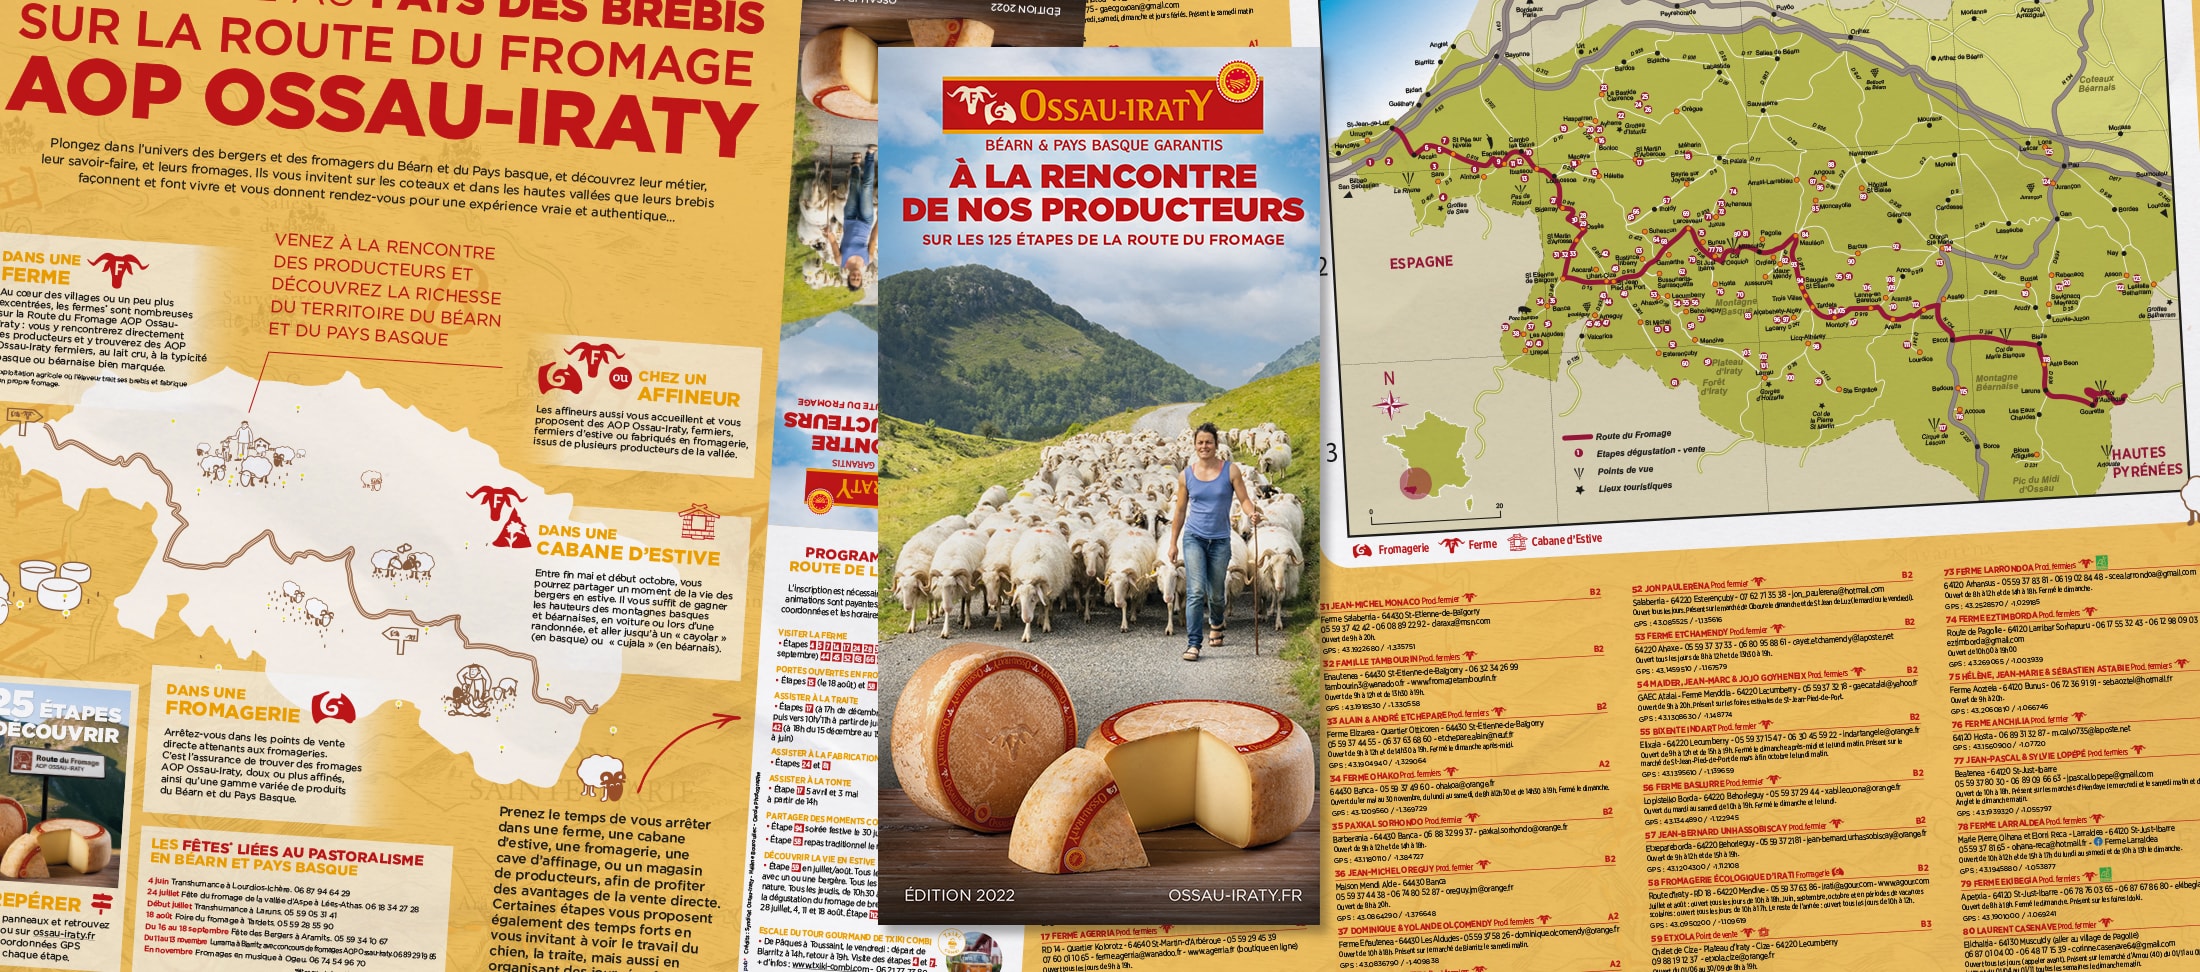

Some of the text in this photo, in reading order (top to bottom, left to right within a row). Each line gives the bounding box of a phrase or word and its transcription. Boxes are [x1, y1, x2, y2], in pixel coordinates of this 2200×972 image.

[498, 0, 587, 22] DES
[601, 0, 764, 34] BREBIS
[990, 2, 1060, 16] ÉDITION 2022
[18, 2, 753, 86] SUR LA ROUTE DU FROMAGE
[2079, 75, 2114, 84] Coteaux
[2078, 83, 2115, 93] Béarnais
[5, 55, 759, 158] AOP OSSAU-IRATY
[1020, 88, 1213, 123] OSSAU-IRATY
[985, 136, 1222, 152] BÉARN & PAYS BASQUE GARANTIS
[50, 137, 706, 192] Plongez dans l'univers des bergers et des fromagers du Béarn et du Pays basque, et découvrez leur métier,
[949, 157, 1256, 188] À LA RENCONTRE
[902, 197, 1304, 222] DE NOS PRODUCTEURS
[275, 232, 495, 260] VENEZ À LA RENCONTRE
[922, 231, 1284, 245] SUR LES 125 ÉTAPES DE LA ROUTE DU FROMAGE
[2, 250, 81, 266] DANS UNE
[1390, 254, 1453, 269] ESPAGNE
[1, 266, 70, 285] FERME
[274, 255, 473, 280] DES PRODUCTEURS ET
[272, 276, 501, 305] DÉCOUVREZ LA RICHESSE
[270, 299, 501, 327] DU TERRITOIRE DU BÉARN
[269, 321, 448, 346] ET DU PAYS BASQUE
[612, 373, 628, 383] ou
[638, 370, 706, 385] CHEZ UN
[1384, 371, 1394, 385] N
[1976, 373, 2018, 383] Montagne
[1976, 382, 2019, 391] Béarnaise
[637, 386, 740, 407] AFFINEUR
[1596, 430, 1671, 441] Route du Fromage
[1326, 442, 1337, 462] 3
[1596, 449, 1624, 459] Etapes
[1626, 447, 1675, 457] dégustation
[1683, 445, 1705, 453] vente
[2112, 446, 2166, 460] HAUTES
[832, 459, 875, 469] GARANTIS
[1597, 466, 1623, 475] Points
[1626, 465, 1636, 473] de
[2113, 461, 2183, 478] PYRÉNÉES
[1623, 481, 1672, 491] touristiques
[538, 524, 617, 540] DANS UNE
[1531, 533, 1602, 546] Cabane d'Estive
[1378, 542, 1429, 555] Fromagerie
[1468, 539, 1497, 549] Ferme
[536, 541, 720, 566] CABANE D'ESTIVE
[789, 561, 865, 576] ROUTE DE
[1943, 568, 1955, 577] 73
[1955, 566, 1983, 576] FERME
[1632, 585, 1643, 594] 52
[778, 628, 847, 640] VISITER LA FERME
[166, 683, 246, 700] DANS UNE
[40, 698, 122, 723] ÉTAPES
[165, 700, 300, 723] FROMAGERIE
[499, 806, 711, 830] Prenez le temps de vous arrêter
[152, 838, 178, 852] LES
[237, 842, 278, 857] LIÉES
[282, 846, 304, 858] AU
[308, 847, 423, 866] PASTORALISME
[150, 851, 358, 876] EN BÉARN ET PAYS BASQUE
[0, 891, 81, 912] EPÉRER
[905, 886, 1014, 901] ÉDITION 2022
[1168, 887, 1303, 902] OSSAU-IRATY.FR
